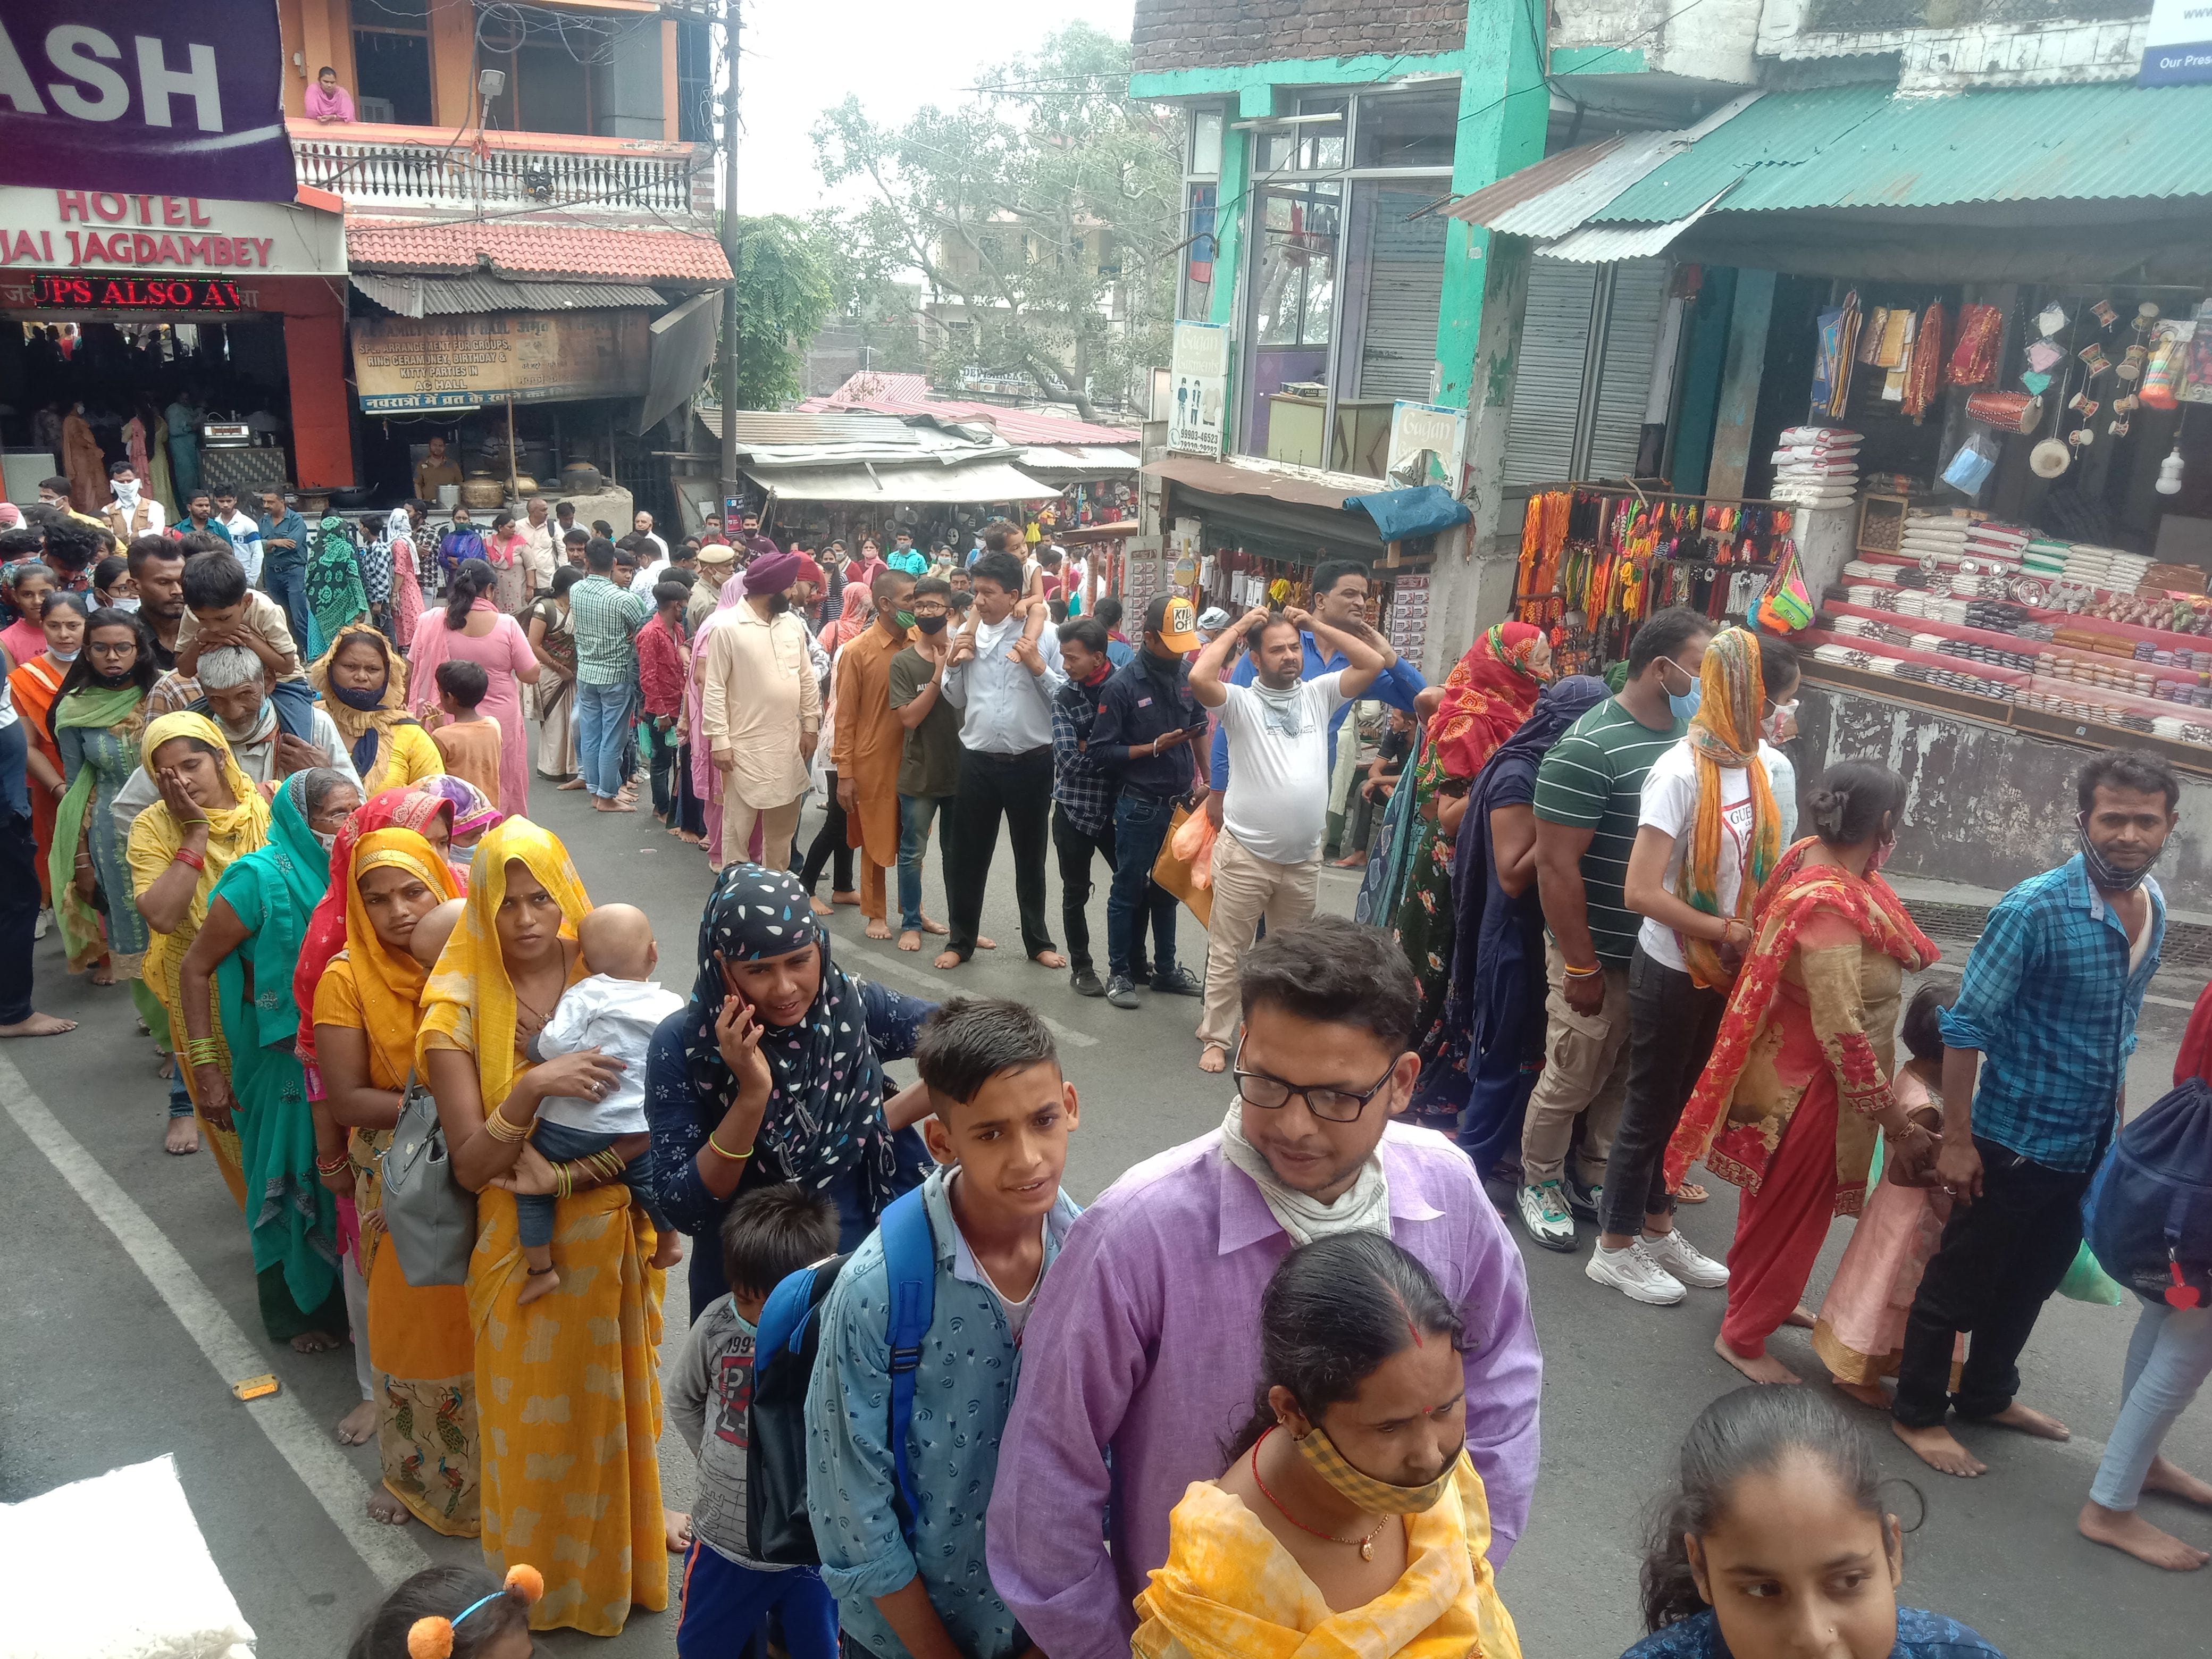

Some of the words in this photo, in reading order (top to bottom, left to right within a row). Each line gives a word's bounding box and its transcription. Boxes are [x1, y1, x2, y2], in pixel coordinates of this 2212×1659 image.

[2160, 58, 2182, 69] Our
[2184, 55, 2212, 66] Pres
[56, 190, 211, 227] HOTEL
[0, 229, 54, 264] JAI
[66, 231, 273, 266] JAGDAMBEY
[101, 281, 192, 305] ALSO
[383, 341, 451, 354] ARRANGEMENT
[453, 340, 471, 351] FOR
[473, 339, 512, 351] GROUPS,
[1182, 329, 1219, 355] Gagan
[367, 356, 391, 367] RING
[453, 353, 497, 364] BIRTHDAY
[499, 352, 507, 363] &
[400, 367, 427, 379] KITTY
[429, 366, 467, 378] PARTIES
[469, 365, 479, 376] IN
[414, 380, 433, 391] AC
[434, 379, 468, 390] HALL
[1403, 411, 1451, 443] Gagan
[1180, 429, 1218, 445] 99903-46523
[1175, 606, 1192, 620] KILL
[726, 1336, 755, 1354] 199
